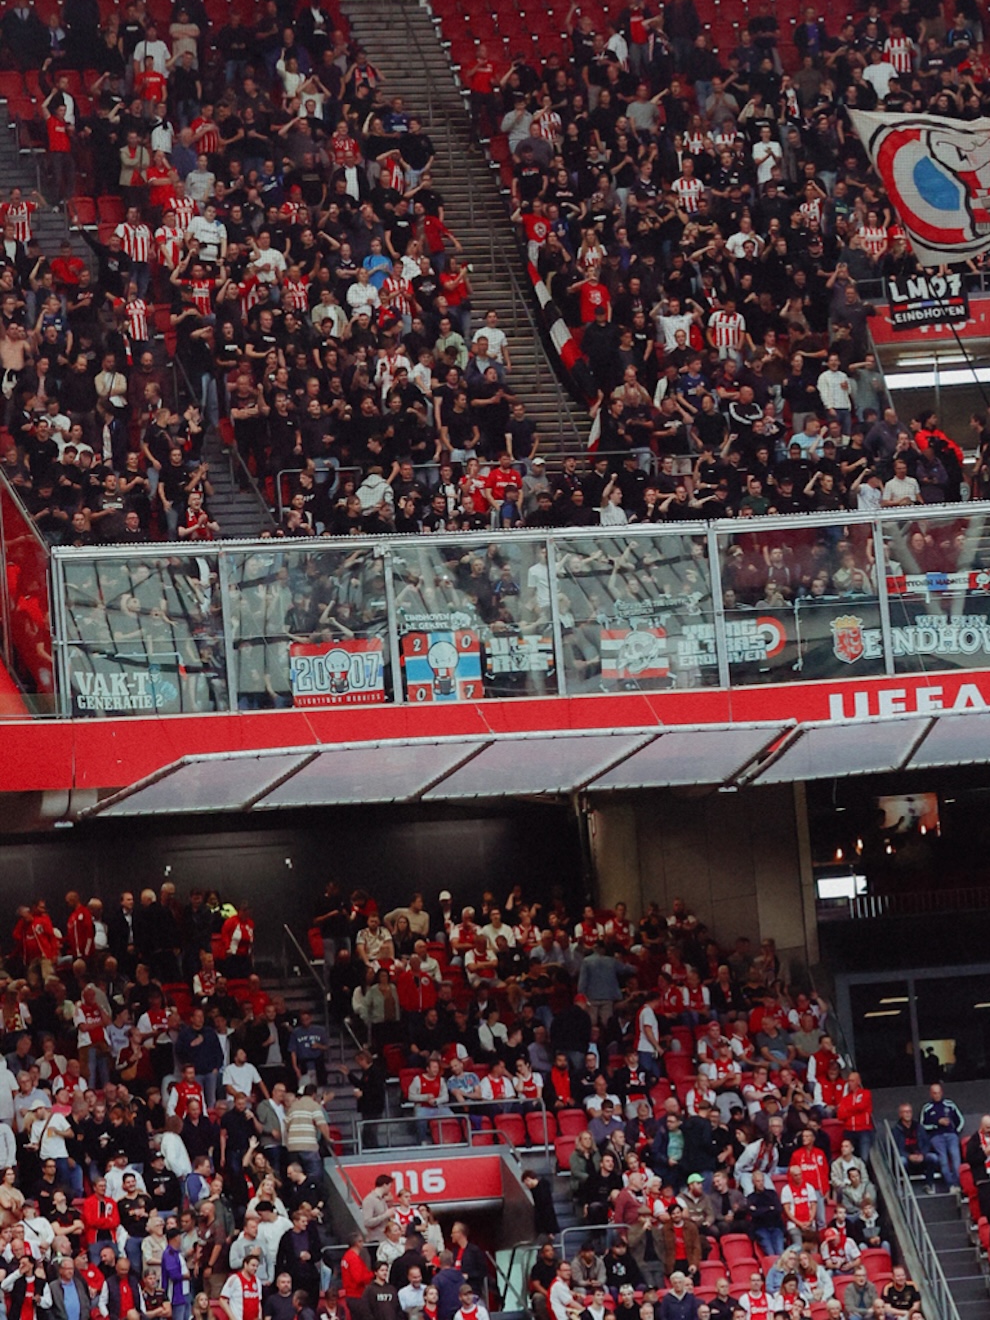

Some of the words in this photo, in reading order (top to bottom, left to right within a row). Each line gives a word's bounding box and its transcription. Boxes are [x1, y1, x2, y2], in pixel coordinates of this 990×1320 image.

[888, 273, 962, 303] LM07
[894, 305, 966, 324] EINDHOVEN
[682, 619, 757, 640] YONG
[412, 637, 422, 652] 2
[461, 634, 472, 649] 0
[74, 671, 149, 696] VAK-T
[416, 687, 426, 701] 0
[464, 684, 475, 699] 7
[77, 695, 153, 710] GENERATIE
[829, 683, 988, 720] UEFA
[391, 1167, 447, 1195] 116
